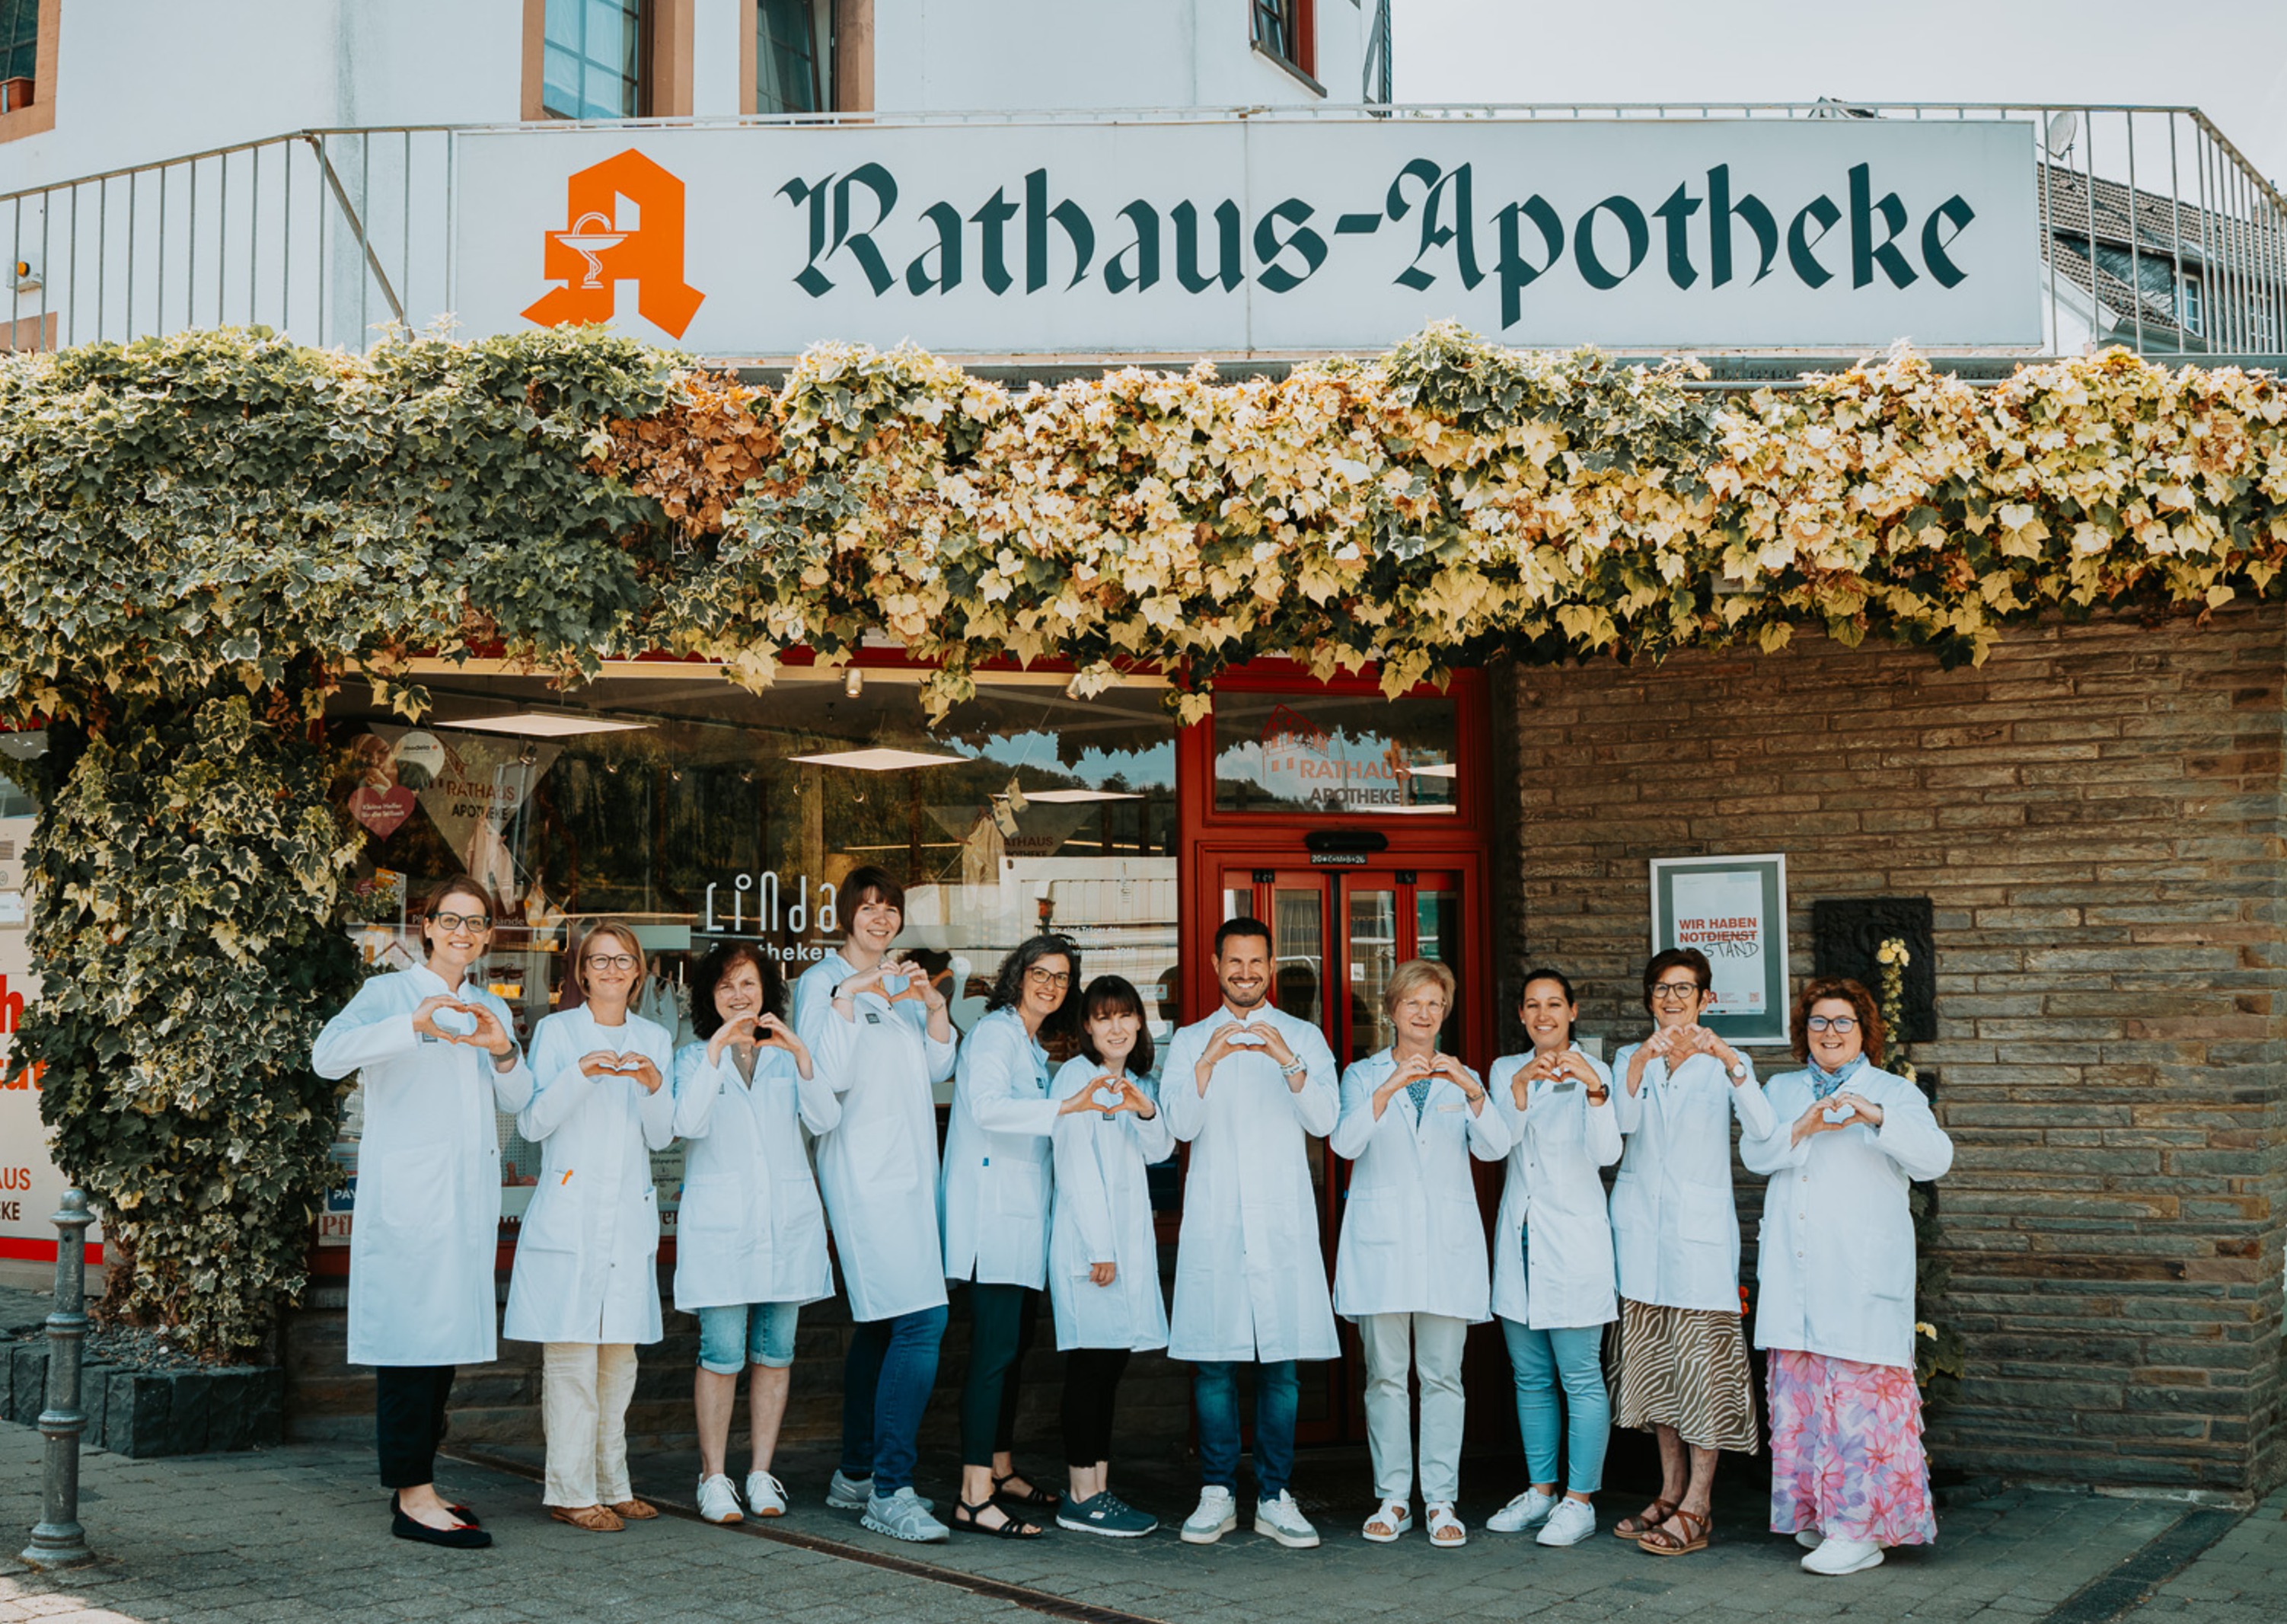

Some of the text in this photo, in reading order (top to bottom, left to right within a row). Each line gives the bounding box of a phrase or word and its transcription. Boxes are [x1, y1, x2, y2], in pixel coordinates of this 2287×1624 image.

[775, 158, 1976, 330] Rathaus-Apotheke
[1300, 759, 1411, 780] RATHAUS
[447, 780, 515, 801] RATHAUS
[1309, 786, 1400, 805] APOTHEKE
[1004, 836, 1054, 847] ATHAUS
[1679, 917, 1757, 930] WIR HABEN
[1679, 930, 1758, 943] NOTDIENST
[710, 942, 837, 962] heken
[1703, 939, 1759, 958] STAND
